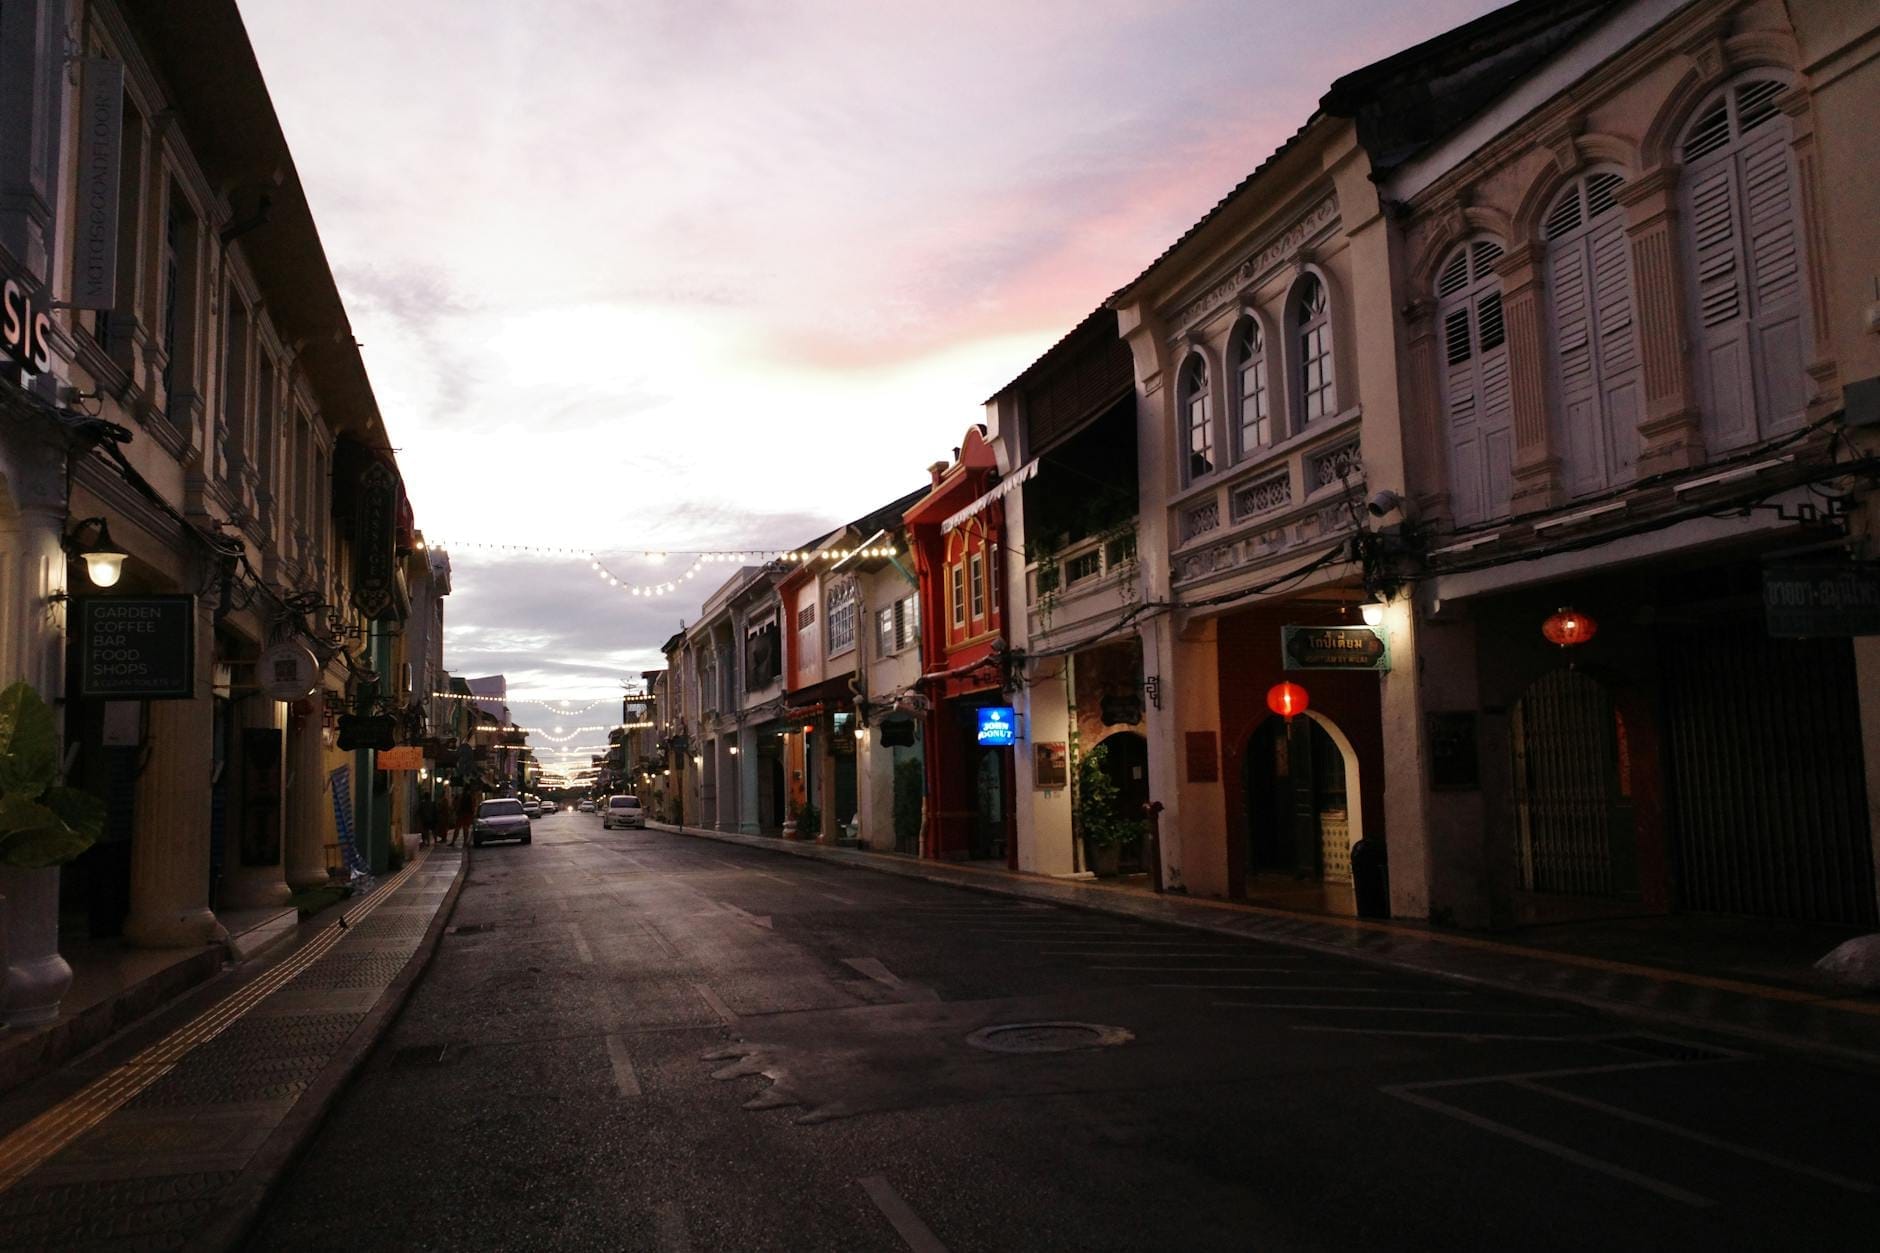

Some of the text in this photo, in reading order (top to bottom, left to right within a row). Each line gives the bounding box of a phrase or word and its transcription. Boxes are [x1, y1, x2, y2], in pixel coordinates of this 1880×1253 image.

[3, 279, 50, 373] SIS
[366, 495, 382, 576] MASSAGE
[94, 607, 161, 618] GARDEN
[94, 621, 156, 632] COFFEE
[93, 635, 127, 647] BAR
[93, 649, 141, 661] FOOD
[93, 663, 148, 676] SHOPS
[983, 722, 1009, 730] JOHN
